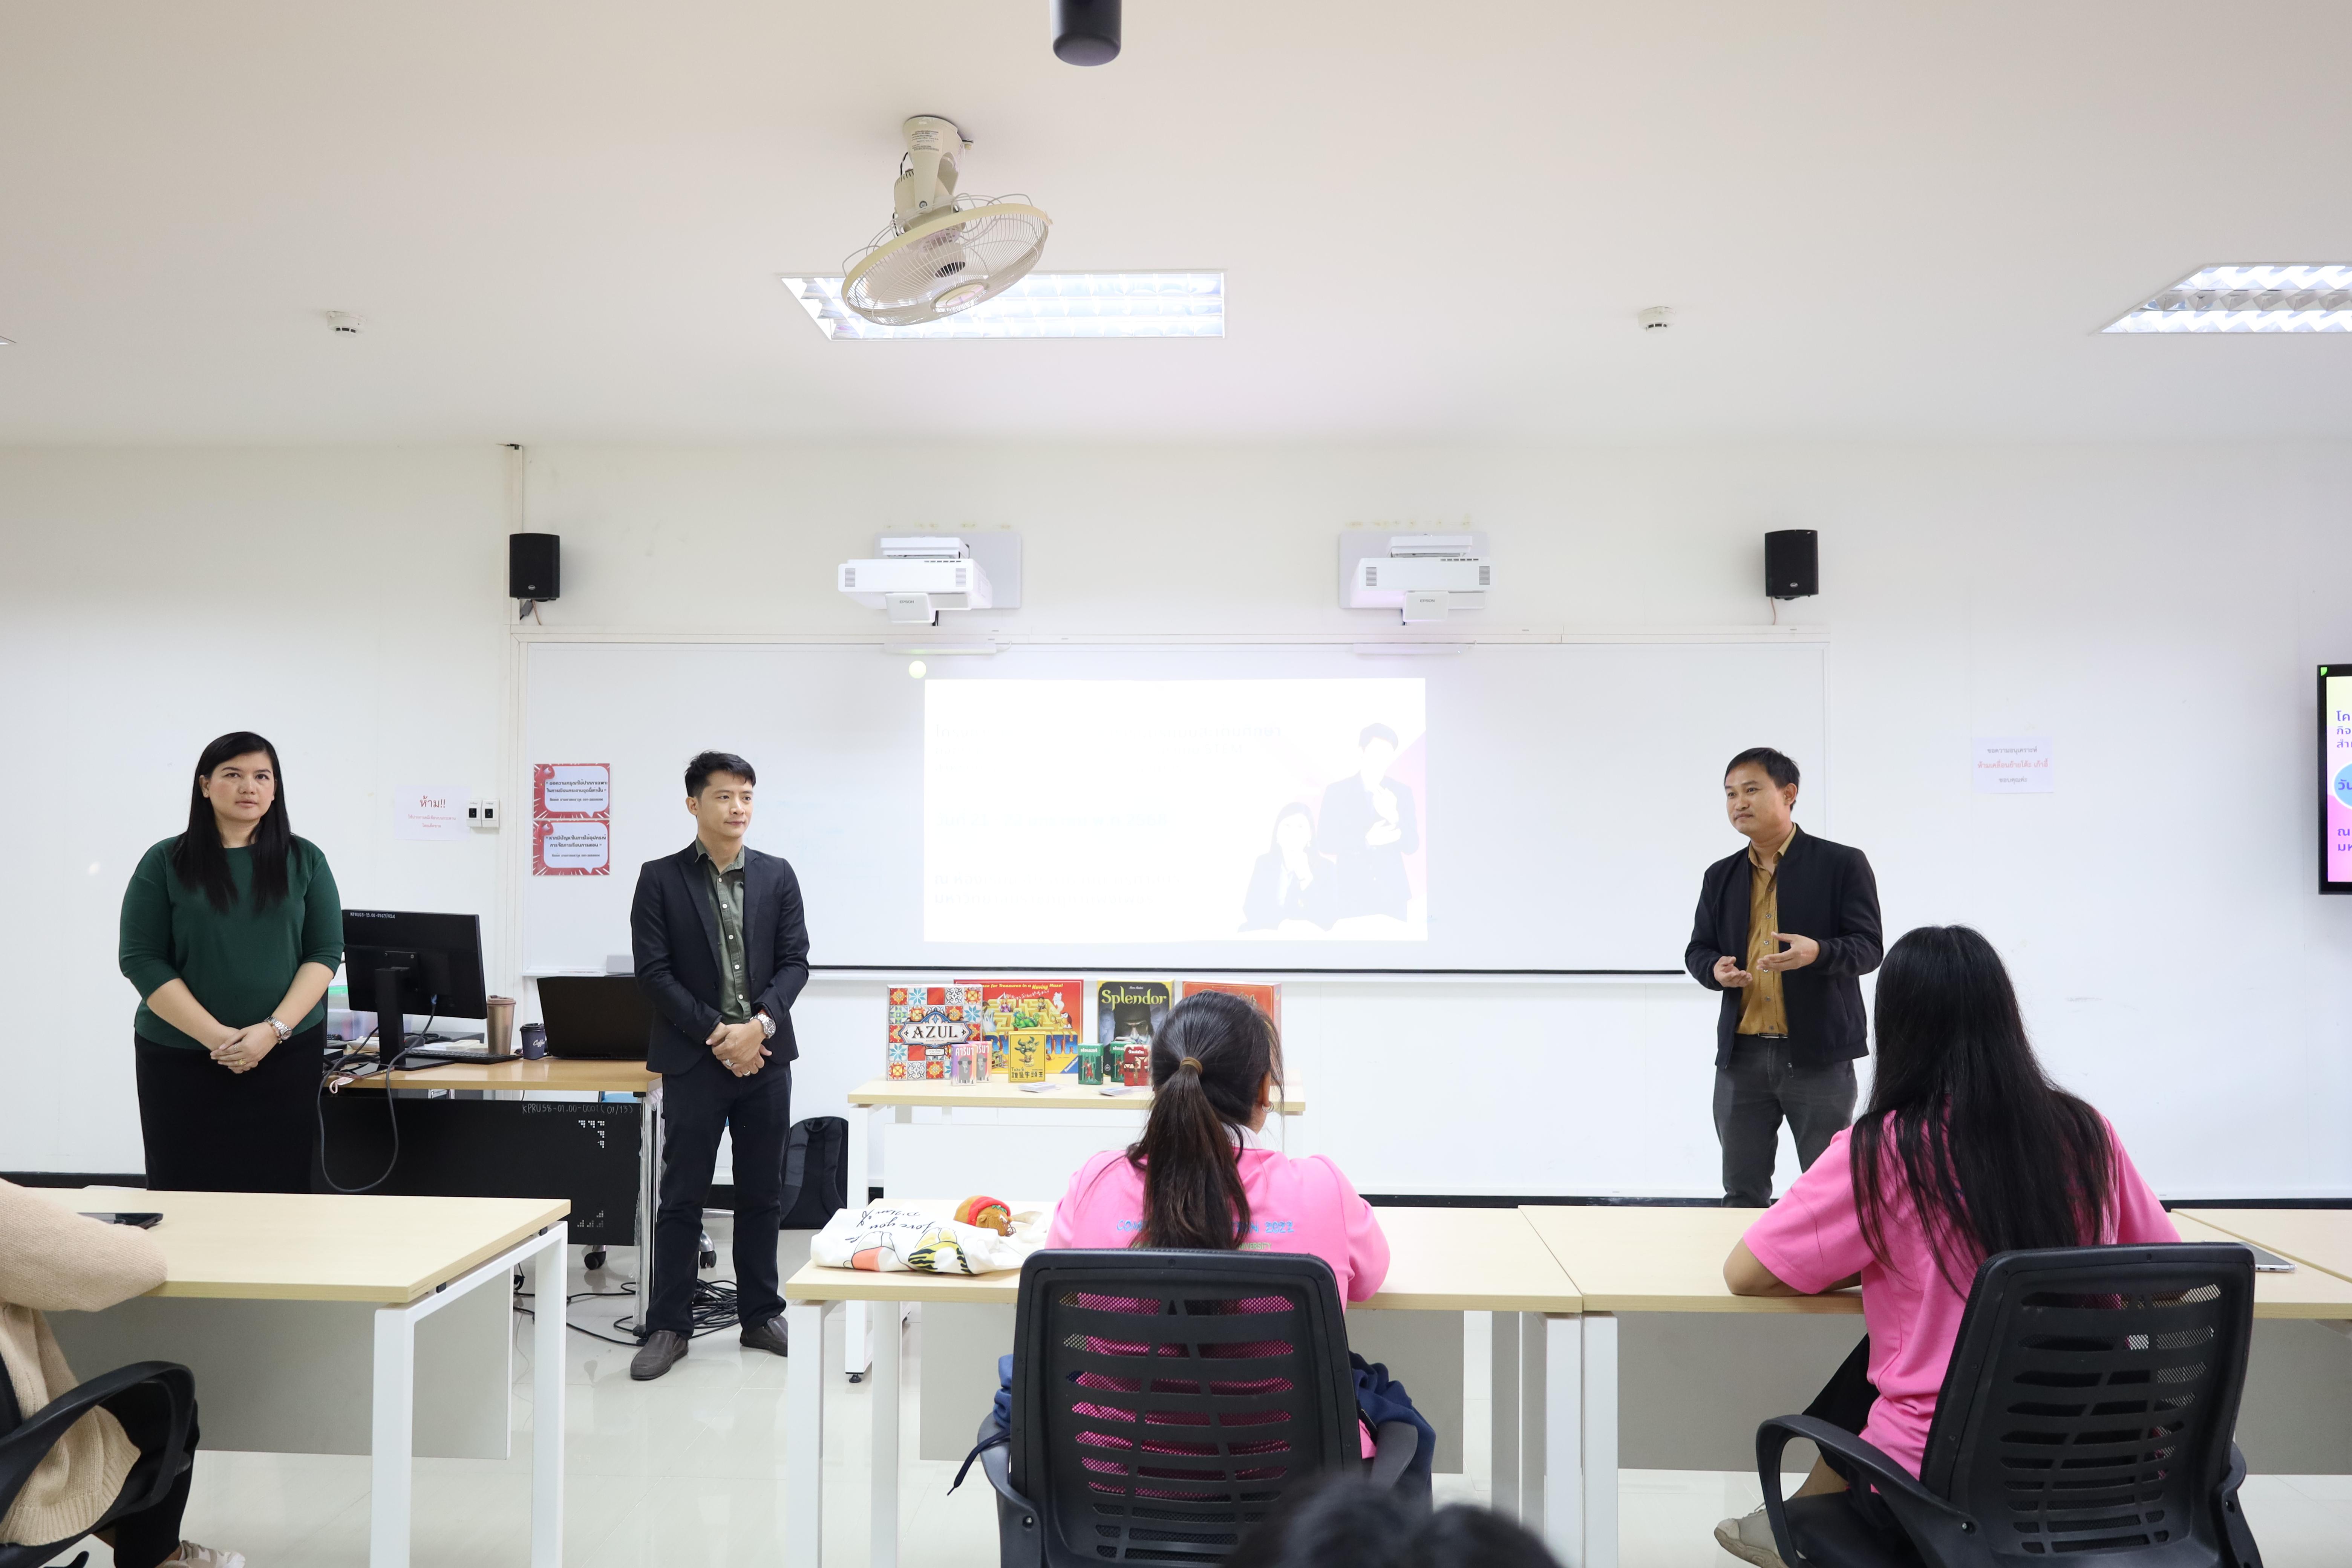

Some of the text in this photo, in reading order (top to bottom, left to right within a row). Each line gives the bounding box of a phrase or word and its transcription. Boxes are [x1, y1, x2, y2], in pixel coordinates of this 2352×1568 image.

[2336, 710, 2352, 721] โค
[420, 795, 446, 808] ห้าม!!
[1101, 986, 1167, 1011] Splendor
[912, 1025, 957, 1038] AZUL
[868, 1216, 936, 1234] Love you
[1265, 1220, 1294, 1234] 2022
[1239, 1242, 1271, 1250] NIVERSITY
